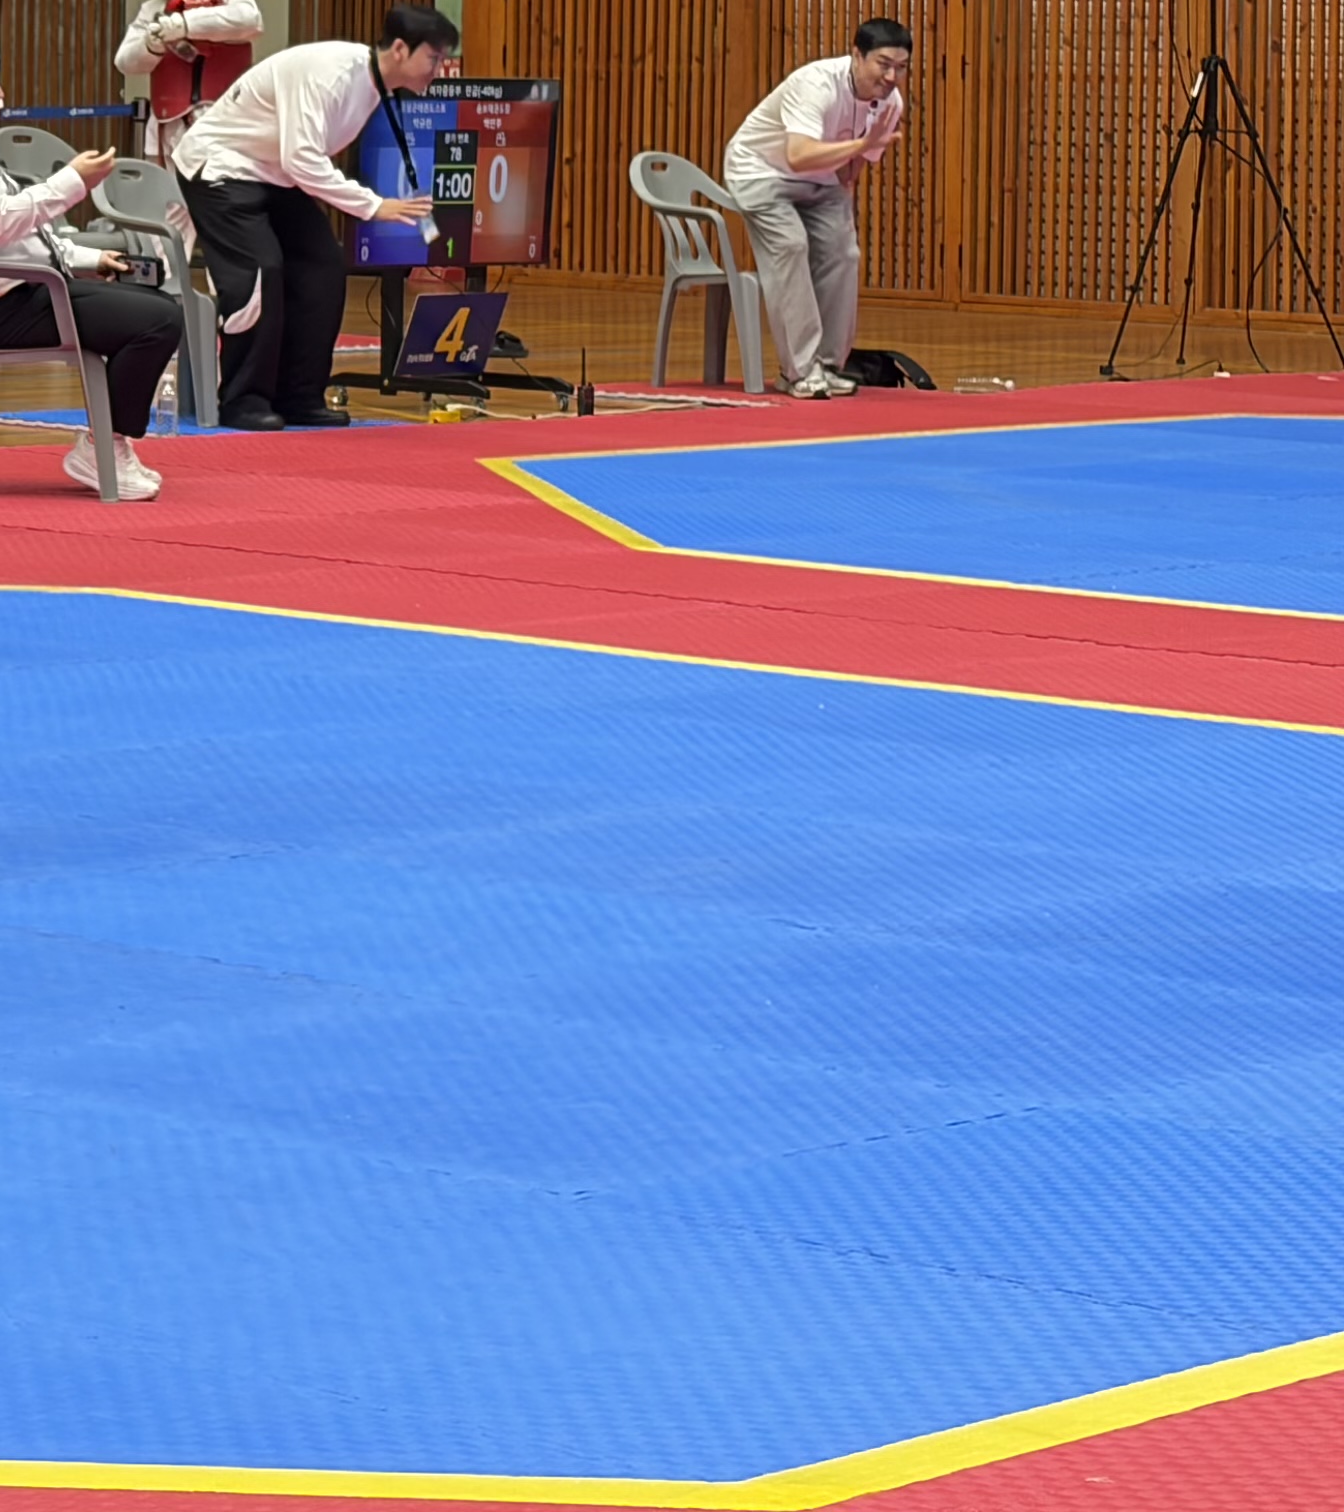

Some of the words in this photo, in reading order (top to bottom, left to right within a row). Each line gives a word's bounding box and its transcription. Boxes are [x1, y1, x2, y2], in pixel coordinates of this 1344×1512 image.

[450, 147, 462, 162] 78
[436, 173, 472, 199] 1:00
[488, 154, 509, 204] 0
[475, 210, 483, 225] 0
[361, 246, 369, 262] 0
[446, 238, 454, 259] 1
[528, 243, 536, 258] 0
[434, 307, 471, 363] 4
